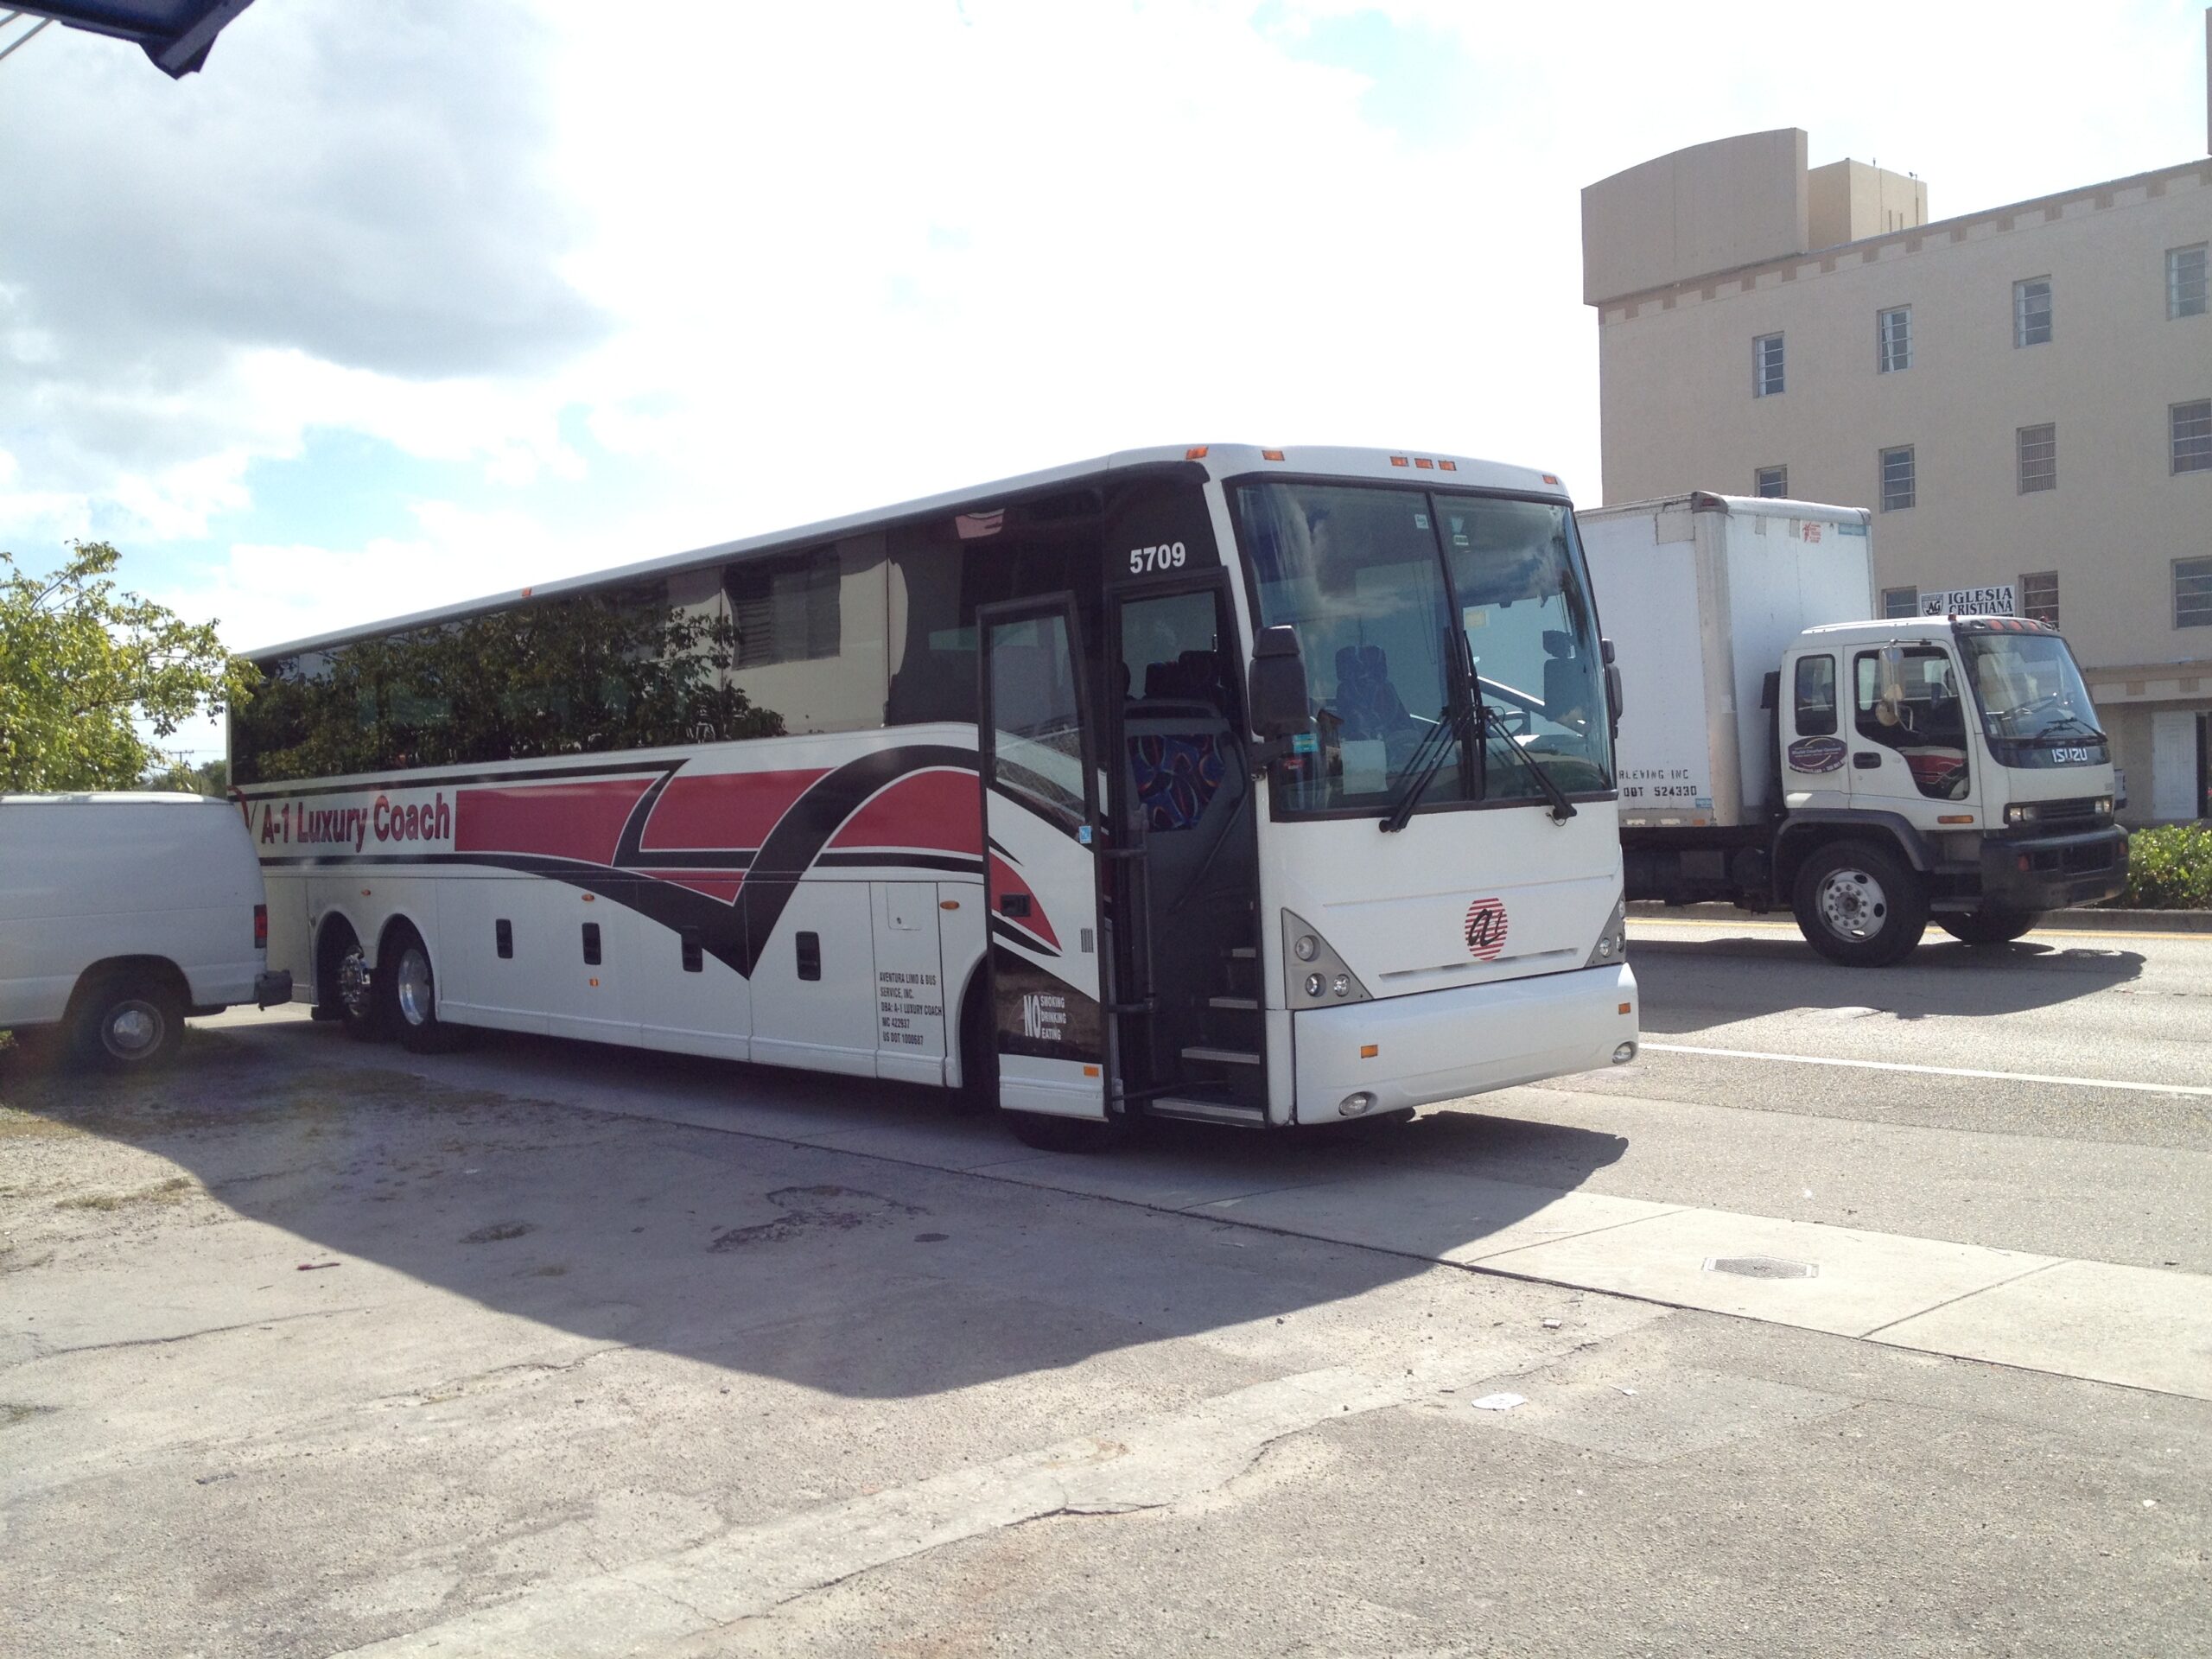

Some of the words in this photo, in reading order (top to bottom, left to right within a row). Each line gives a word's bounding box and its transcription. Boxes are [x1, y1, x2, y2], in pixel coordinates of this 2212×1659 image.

[1129, 541, 1186, 574] 5709
[1948, 588, 2012, 604] IGLESIA
[1949, 600, 2012, 616] CRISTIANA
[2051, 747, 2088, 762] ISUZU
[1671, 769, 1689, 779] INC
[1654, 785, 1697, 797] 524330
[261, 803, 289, 843] A-1
[296, 801, 368, 853] Luxury
[373, 792, 450, 842] Coach
[880, 972, 905, 983] AVENTURA
[906, 974, 918, 984] LIMO
[920, 975, 925, 984] &
[925, 975, 937, 986] BUS
[880, 987, 903, 999] SERVICE,
[904, 988, 914, 999] INC.
[1040, 995, 1065, 1008] SMOKING
[904, 1004, 923, 1014] LUXURY
[924, 1005, 943, 1016] COACH
[882, 1017, 890, 1027] MC
[1023, 995, 1041, 1039] NO
[1041, 1011, 1067, 1024] DRINKING
[883, 1031, 890, 1042] US
[890, 1032, 900, 1043] DOT
[1041, 1027, 1062, 1040] EATING
